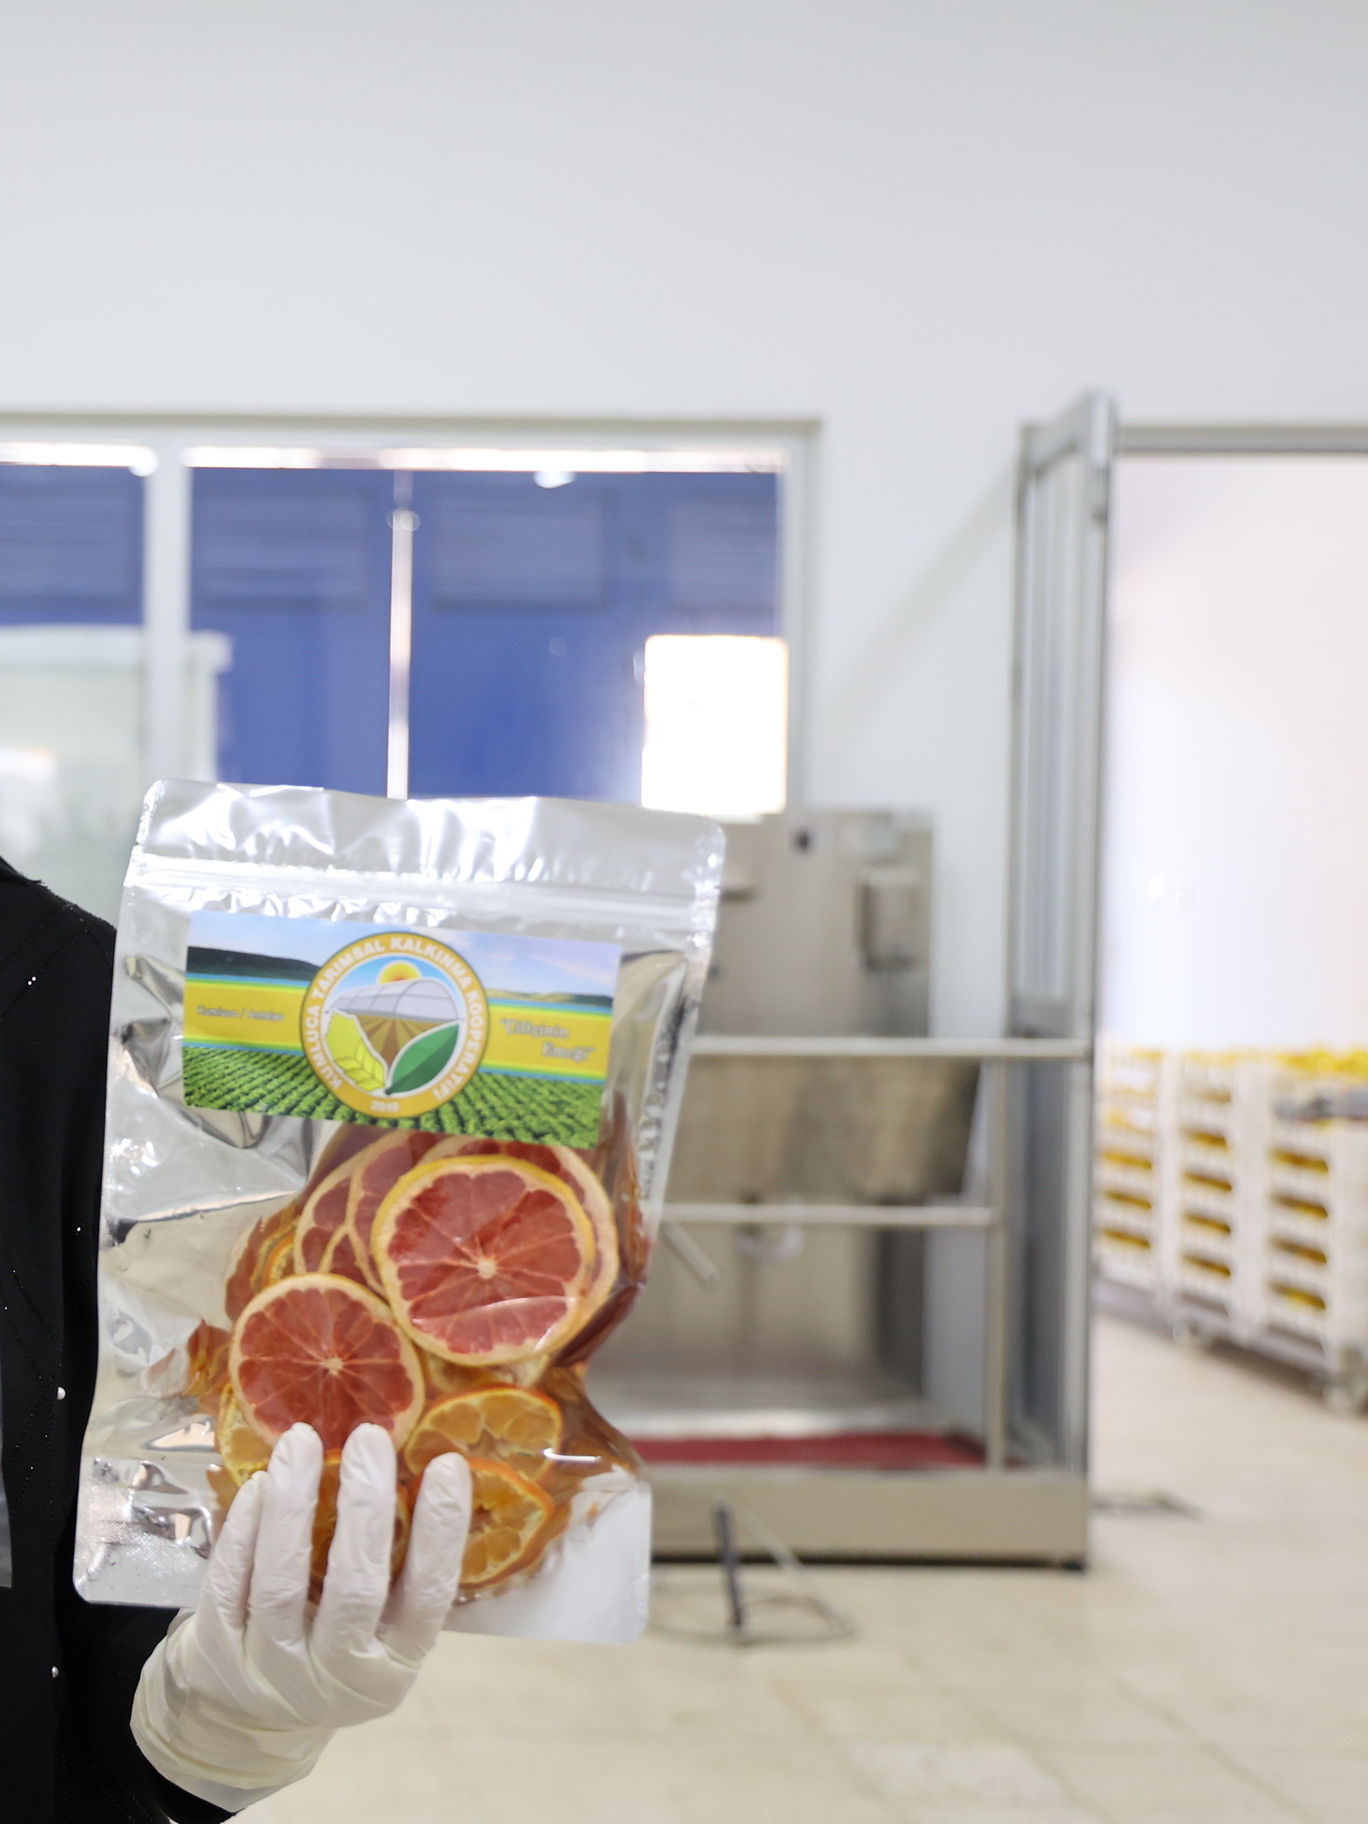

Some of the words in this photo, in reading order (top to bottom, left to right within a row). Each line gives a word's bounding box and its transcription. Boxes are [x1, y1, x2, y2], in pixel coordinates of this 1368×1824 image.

[312, 939, 386, 998] TARIMSAL
[391, 937, 473, 989] KALKINMA
[306, 1005, 342, 1089] KUMLUCA
